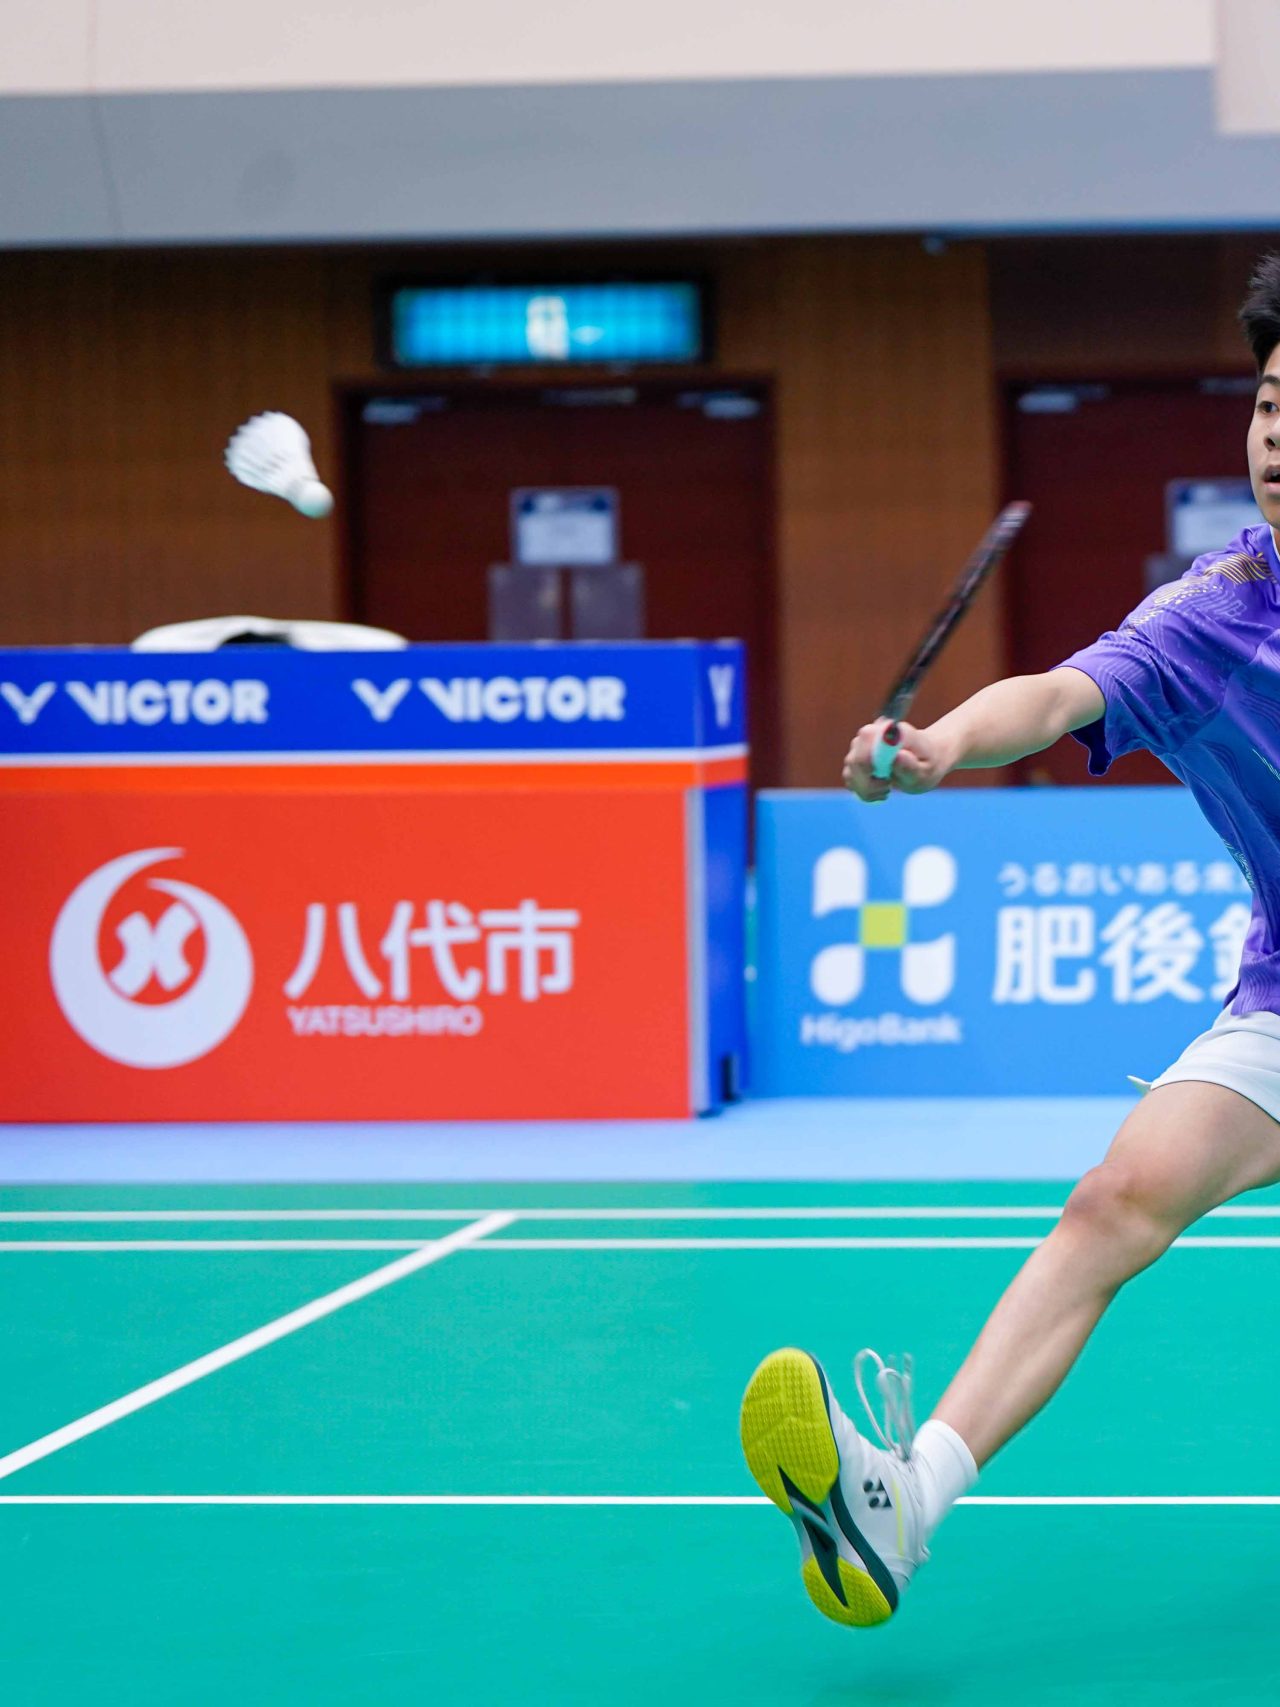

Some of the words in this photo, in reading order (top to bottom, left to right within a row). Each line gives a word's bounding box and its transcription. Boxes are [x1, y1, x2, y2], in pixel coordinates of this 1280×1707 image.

[67, 679, 270, 725] VICTOR
[419, 676, 626, 722] VICTOR
[998, 861, 1251, 897] うるおいある未
[284, 899, 580, 1002] 八代市
[286, 1005, 484, 1036] YATSUSHIRO
